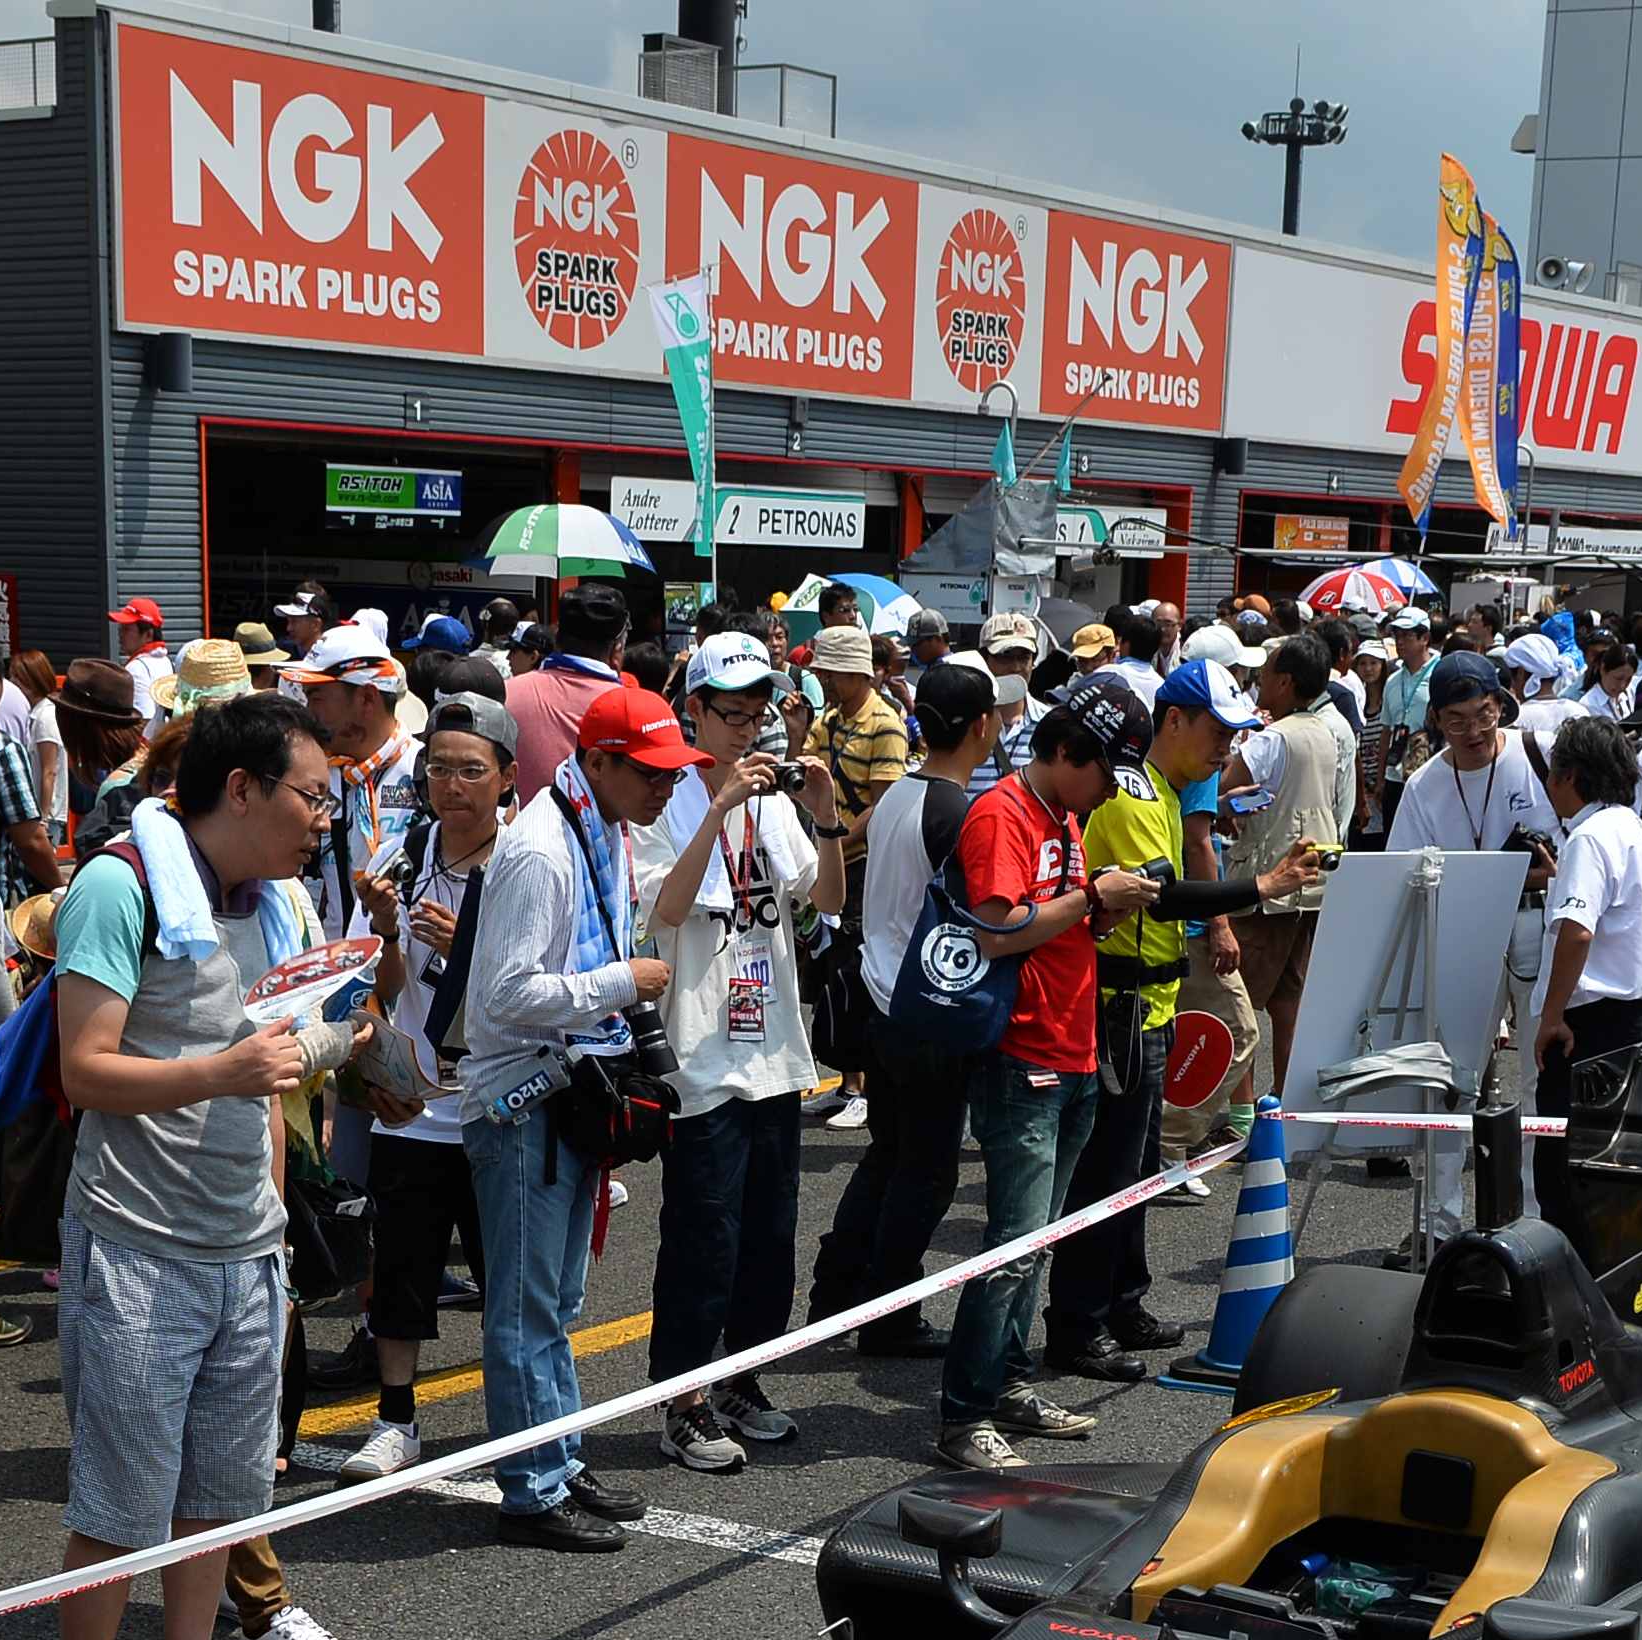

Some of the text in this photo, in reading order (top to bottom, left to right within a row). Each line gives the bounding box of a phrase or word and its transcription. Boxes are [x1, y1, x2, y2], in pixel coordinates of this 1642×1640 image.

[169, 67, 445, 265] NGK
[534, 175, 621, 240] NGK
[699, 166, 892, 323] NGK
[535, 249, 619, 287] SPARK
[950, 247, 1013, 299] NGK
[173, 250, 442, 325] SPARK PLUGS
[535, 284, 619, 321] PLUGS
[1066, 235, 1209, 366] NGK
[950, 308, 1010, 341] SPARK
[795, 328, 883, 374] PLUGS
[949, 337, 1009, 368] PLUGS
[1064, 362, 1201, 410] SPARK PLUGS
[1385, 300, 1639, 458] SWA
[413, 400, 421, 421] 1
[793, 432, 801, 451] 2
[1081, 455, 1089, 472] 3
[621, 488, 661, 510] Andre
[628, 508, 679, 533] Lotterer
[758, 508, 858, 540] PETRONAS
[434, 568, 473, 583] asaki
[1559, 1359, 1595, 1394] TOYOTA
